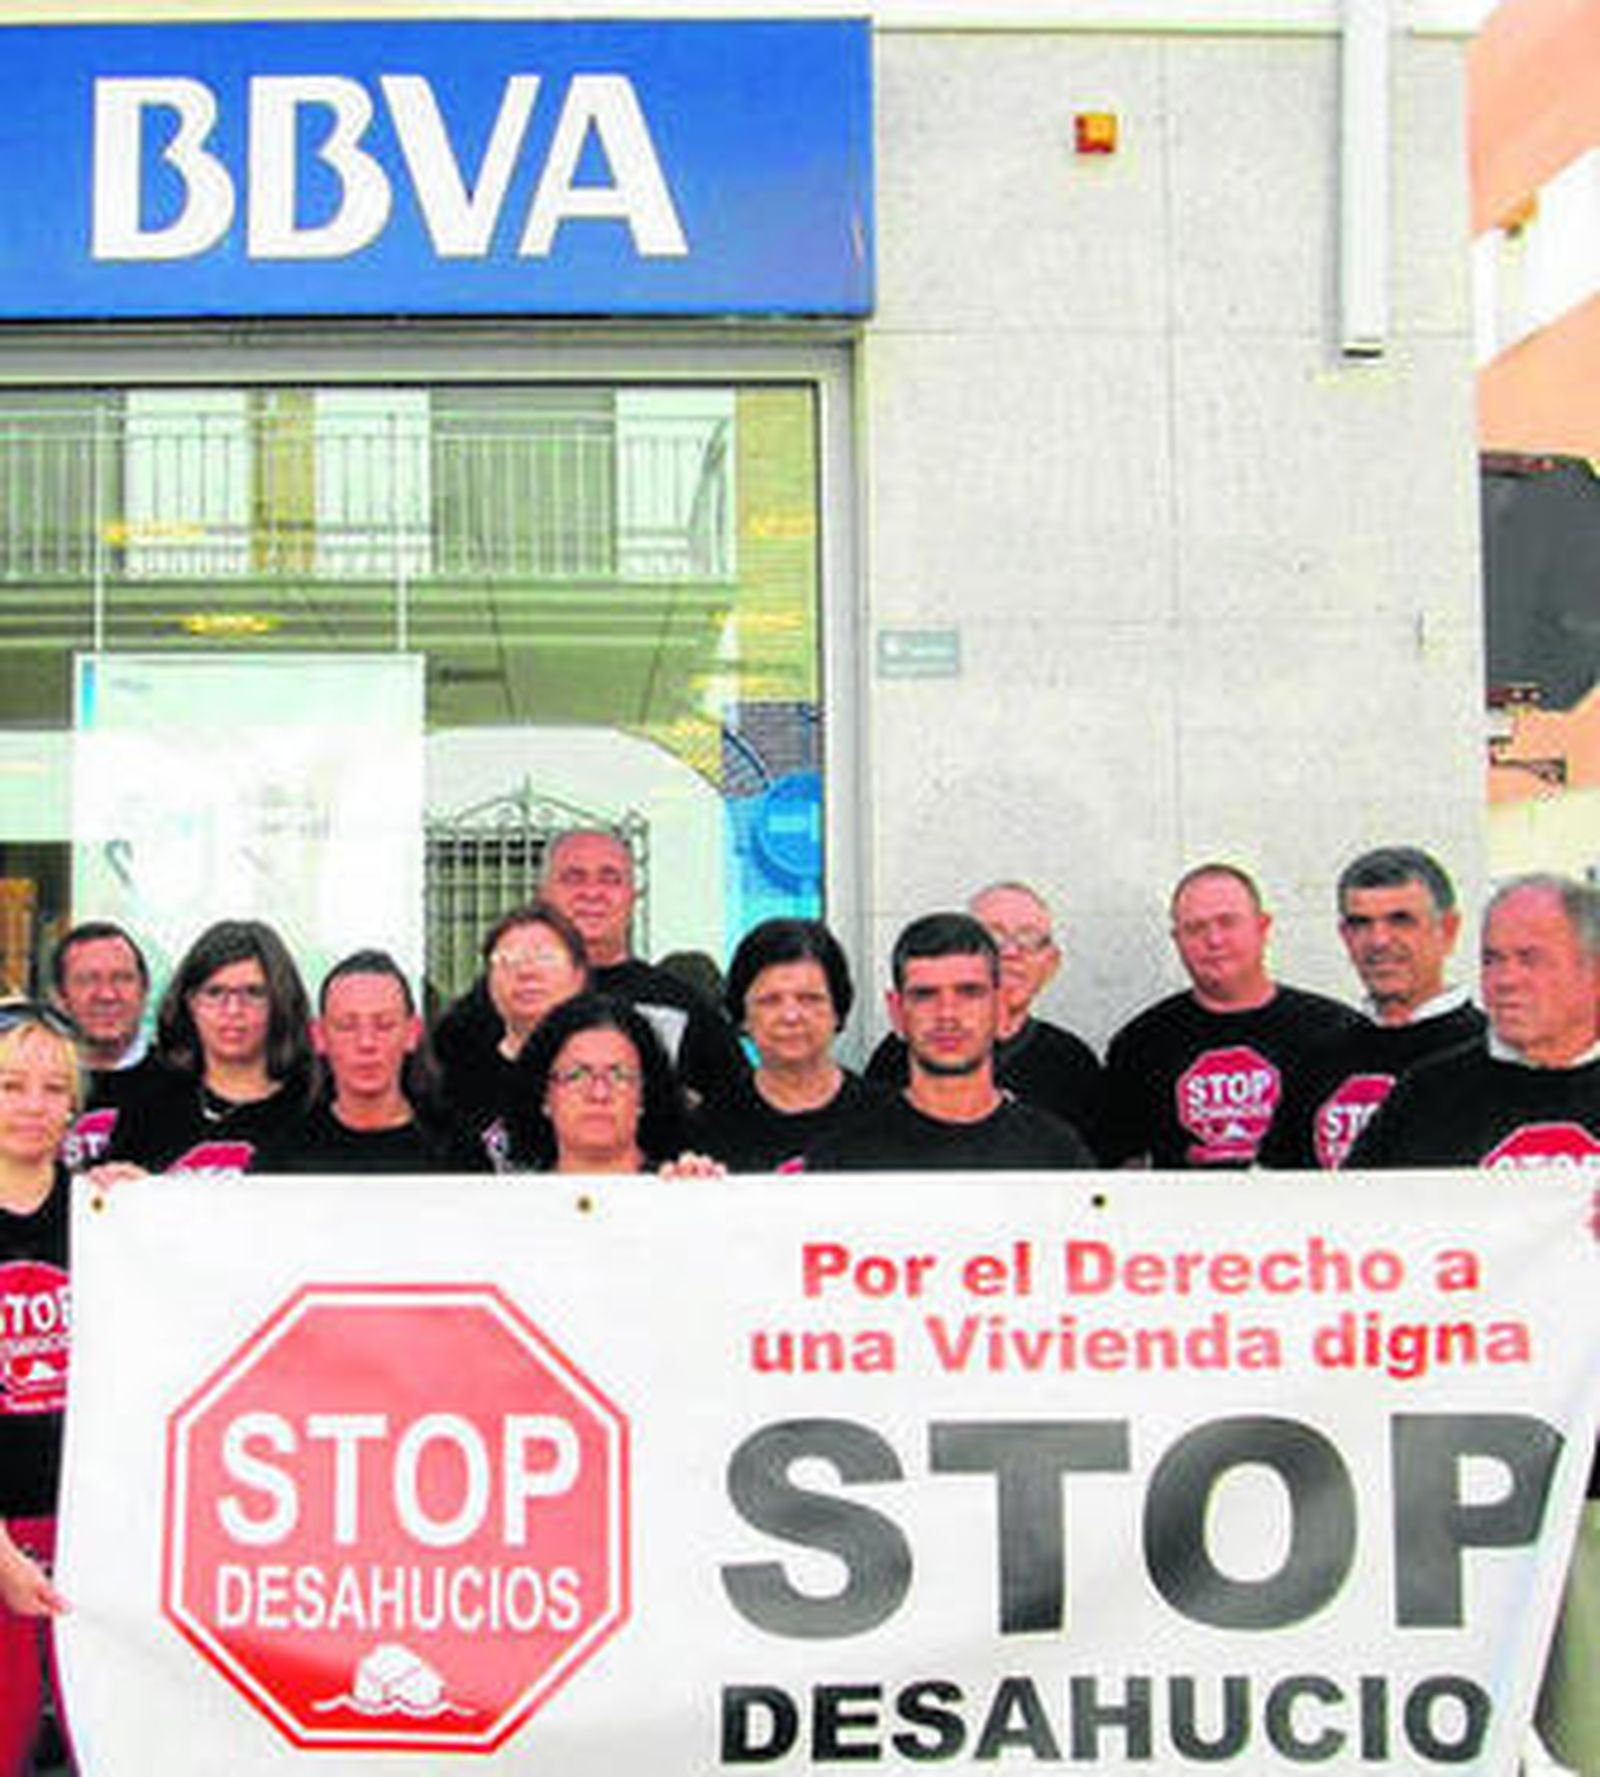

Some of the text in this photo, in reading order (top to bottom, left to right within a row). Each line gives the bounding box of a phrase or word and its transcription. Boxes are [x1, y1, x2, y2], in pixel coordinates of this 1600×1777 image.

[92, 74, 689, 260] BBVA
[1188, 1070, 1271, 1106] STOP
[802, 1236, 1482, 1299] Por el Derecho a
[751, 1310, 1532, 1381] una Vivienda digna
[217, 1411, 582, 1548] STOP
[720, 1413, 1566, 1641] STOP
[216, 1565, 582, 1631] DESAHUCIOS
